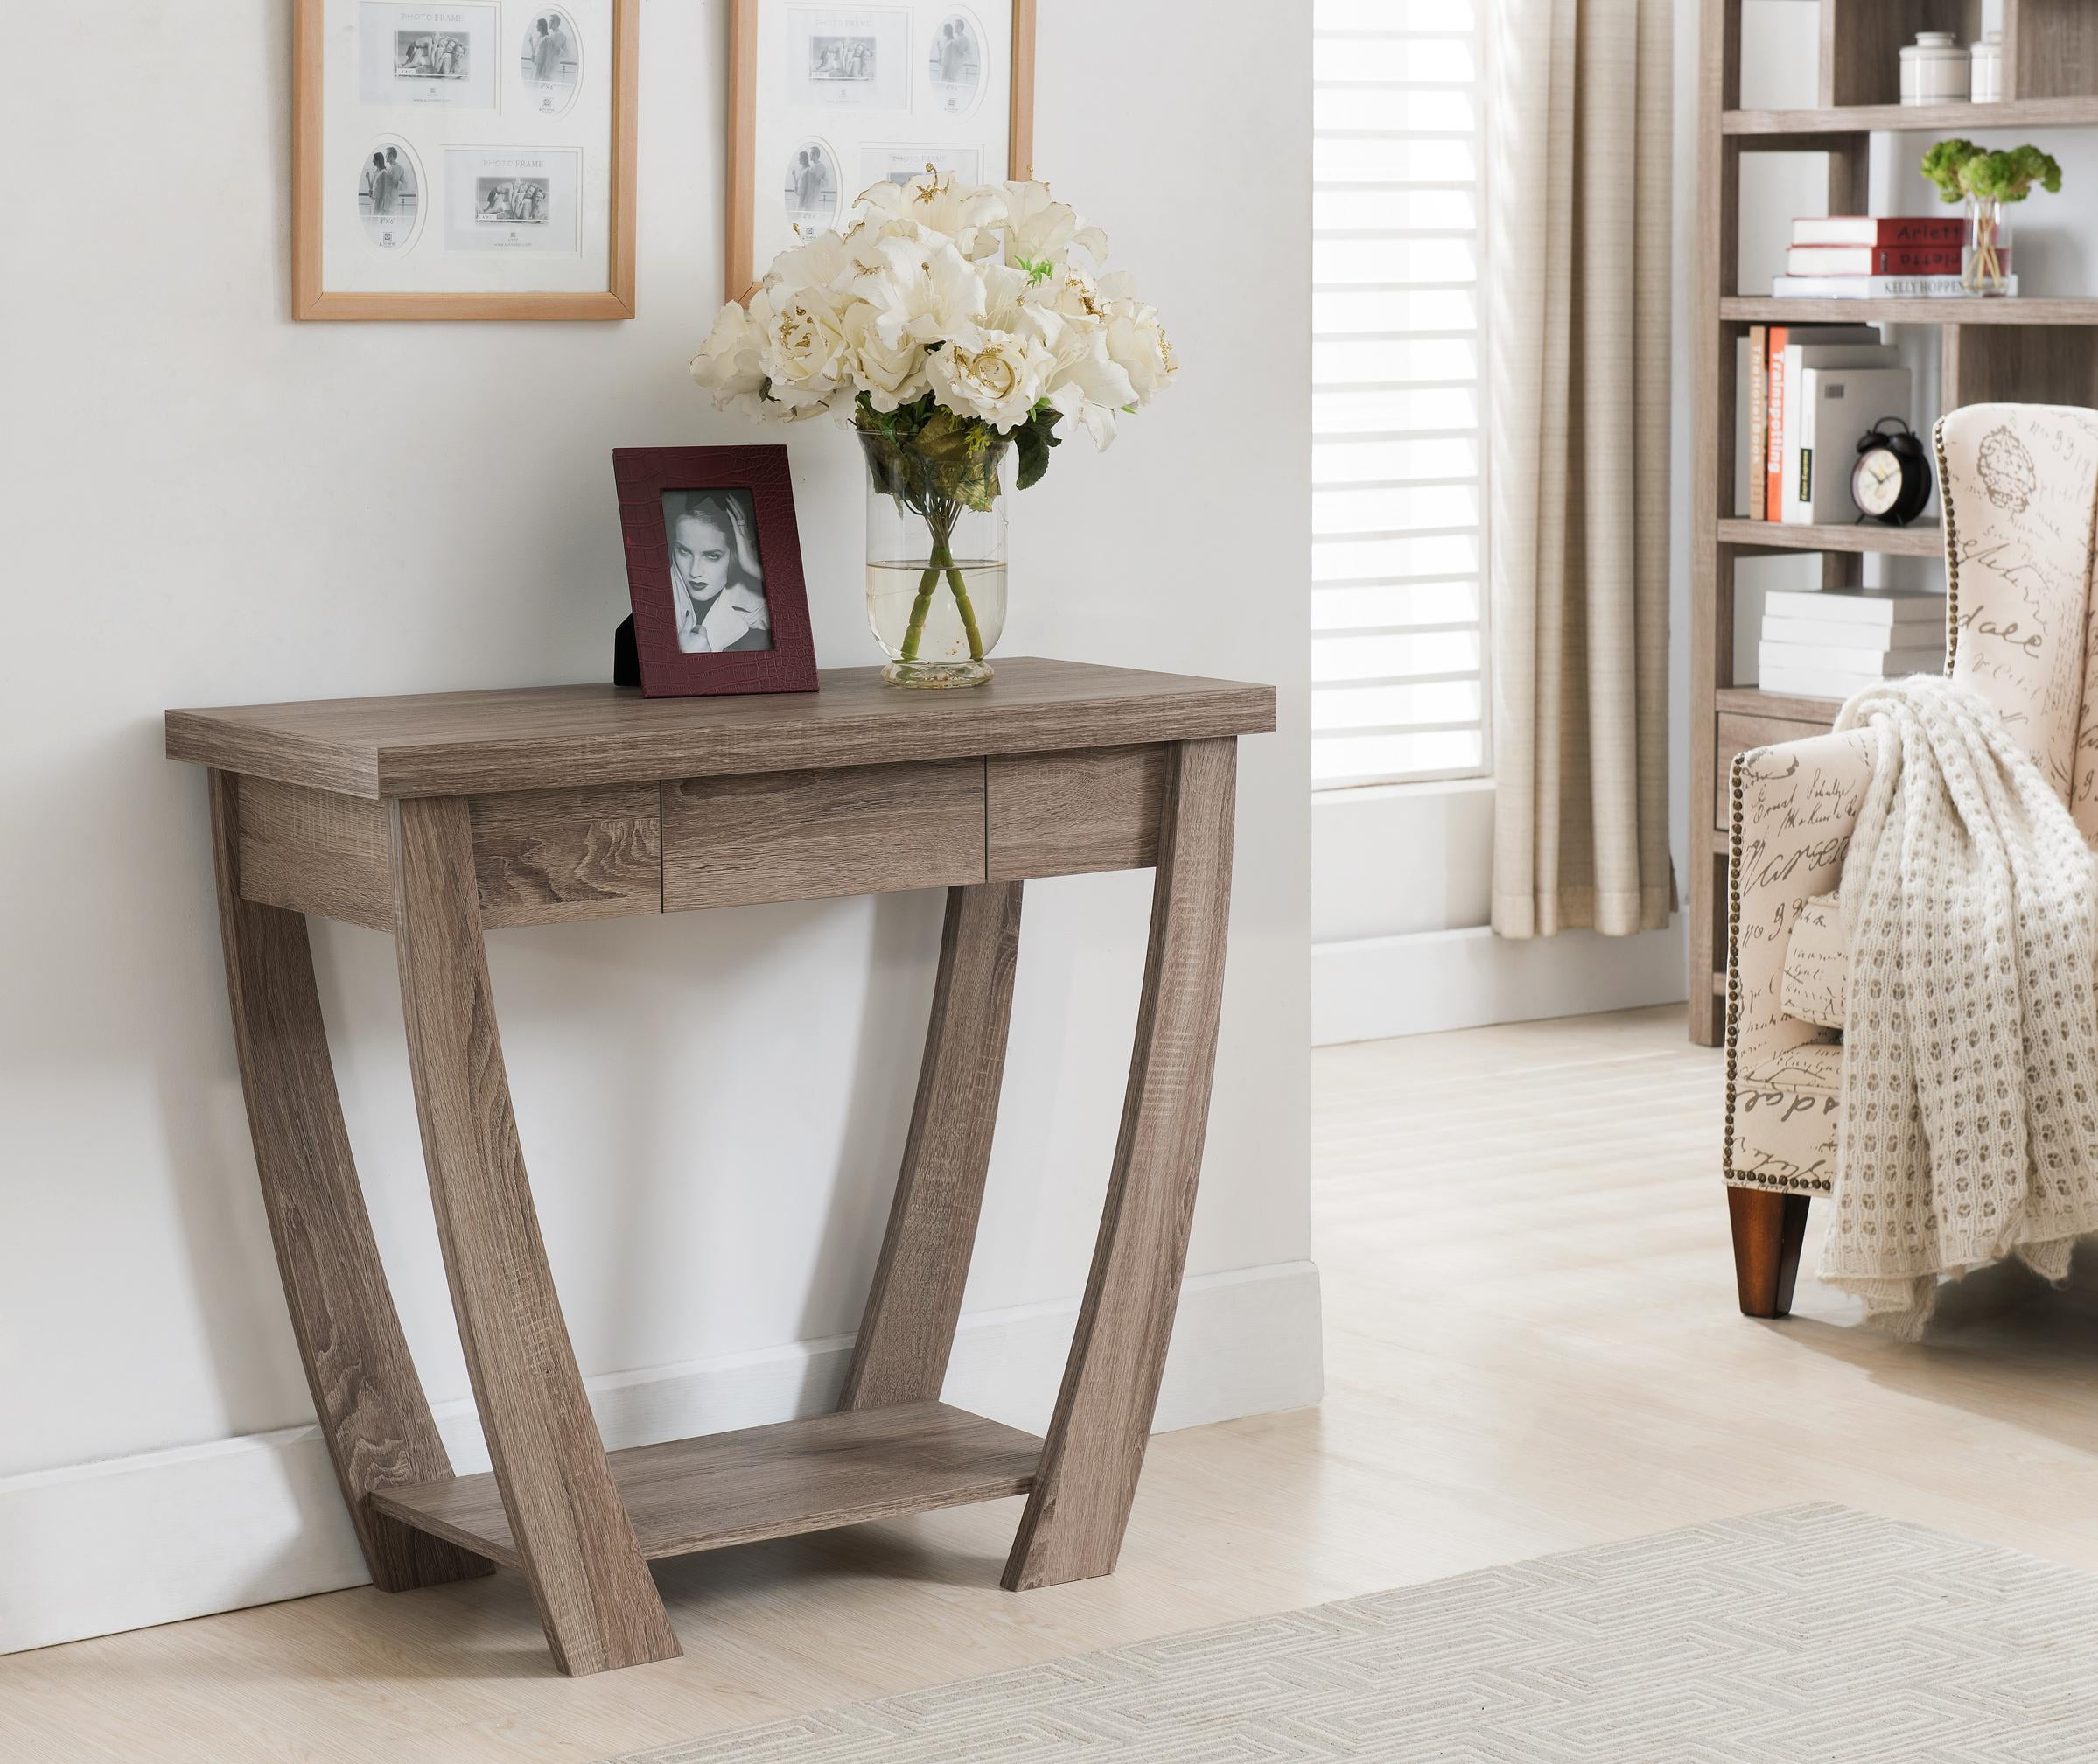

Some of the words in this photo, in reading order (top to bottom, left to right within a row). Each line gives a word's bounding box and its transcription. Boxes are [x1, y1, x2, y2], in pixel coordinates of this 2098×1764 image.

[434, 13, 464, 22] FRAME
[1897, 223, 1962, 239] Arlett
[1884, 279, 1920, 295] KELLY
[1752, 344, 1761, 374] The
[1752, 376, 1761, 421] Hotel
[1768, 349, 1785, 473] Trainspotting
[1752, 423, 1761, 464] Book
